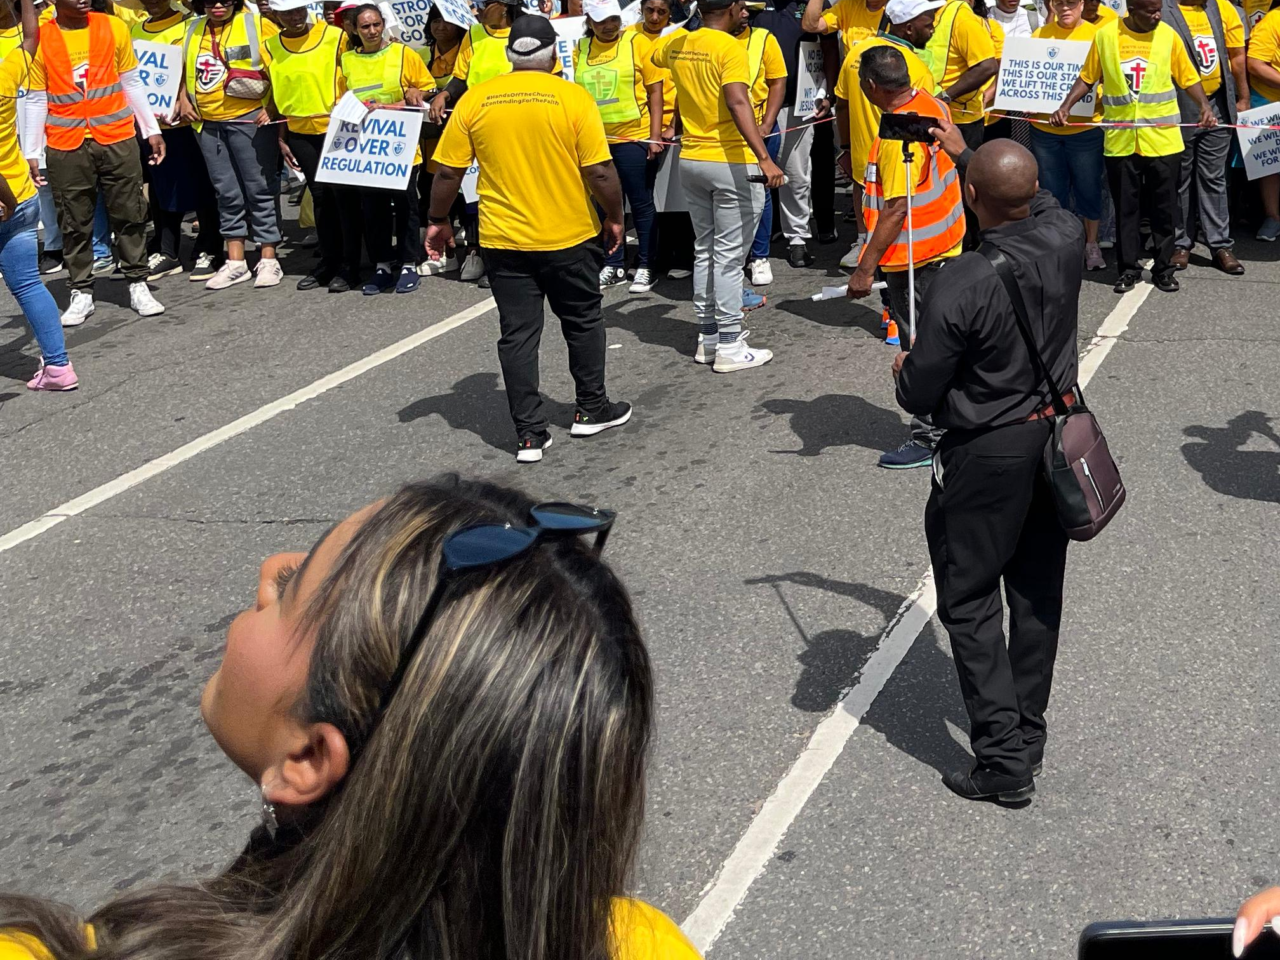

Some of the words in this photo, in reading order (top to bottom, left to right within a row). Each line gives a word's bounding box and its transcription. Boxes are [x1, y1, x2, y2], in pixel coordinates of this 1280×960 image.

[1009, 59, 1030, 69] THIS
[1032, 61, 1041, 69] IS
[1043, 62, 1064, 71] OUR
[1002, 69, 1023, 78] THIS
[1025, 70, 1034, 79] IS
[1036, 71, 1058, 81] OUR
[1002, 78, 1016, 88] WE
[1019, 80, 1038, 89] LIFT
[1040, 81, 1058, 90] THE
[999, 89, 1040, 99] ACROSS
[1042, 92, 1063, 101] THIS
[340, 118, 406, 138] REVIVAL
[344, 137, 389, 157] OVER
[1248, 136, 1262, 146] WE
[1253, 150, 1268, 161] WE
[1261, 156, 1279, 167] FOR
[321, 156, 408, 178] REGULATION
